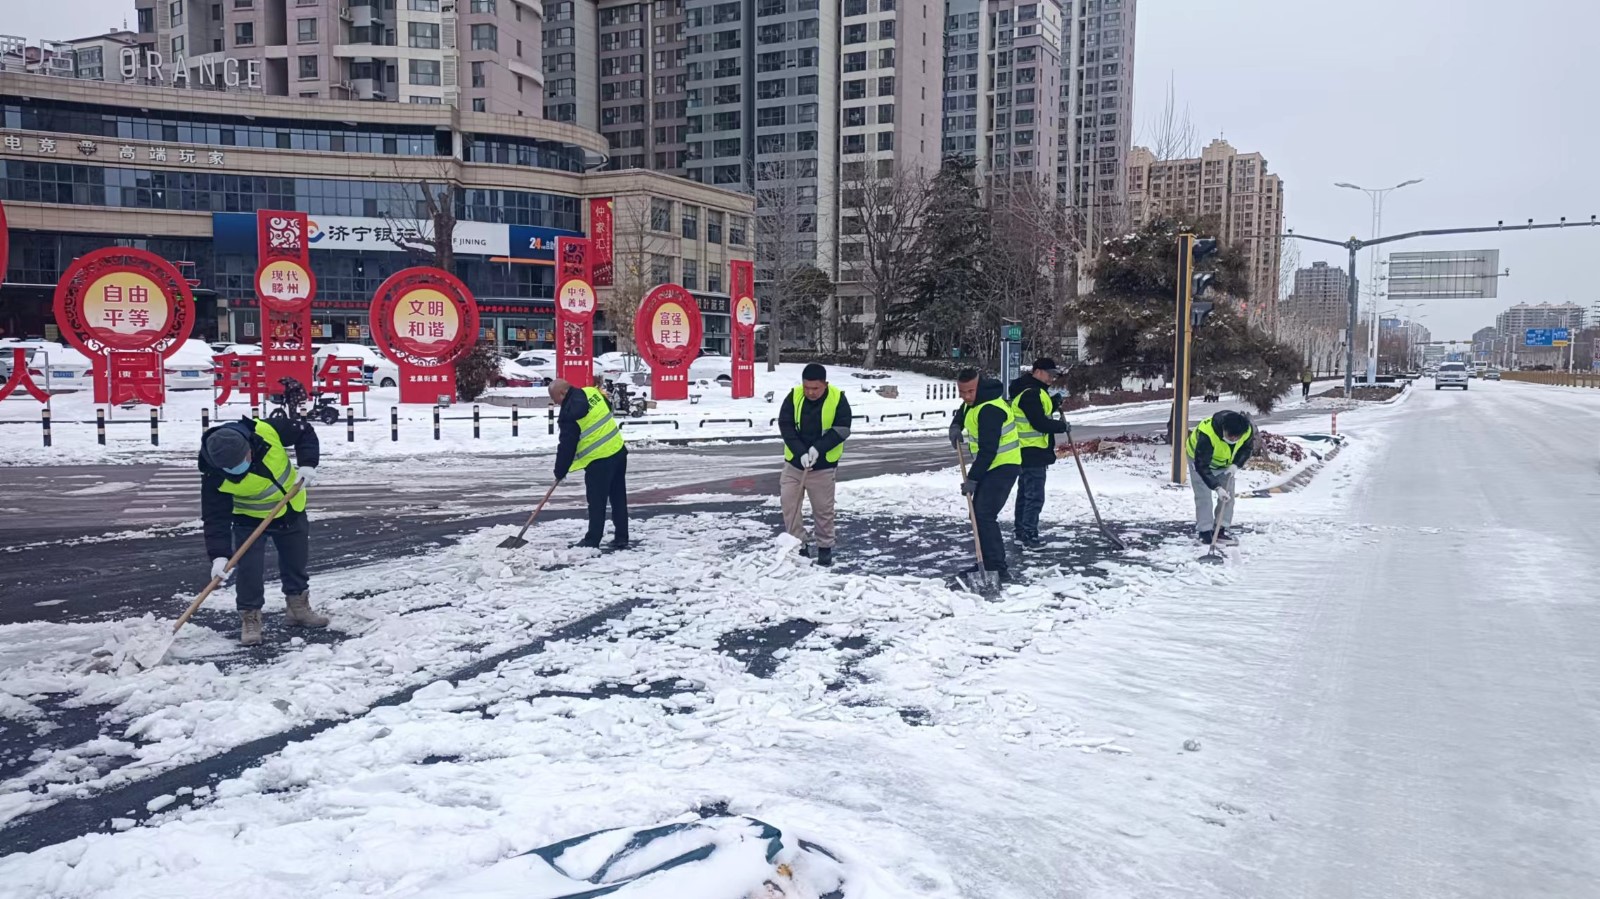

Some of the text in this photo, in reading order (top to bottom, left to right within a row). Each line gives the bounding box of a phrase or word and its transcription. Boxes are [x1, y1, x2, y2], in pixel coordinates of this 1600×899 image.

[119, 47, 262, 89] ORANGE
[4, 134, 226, 166] 电竞 高端玩家
[328, 226, 418, 243] 济宁银行
[595, 205, 606, 250] 仲家汇
[459, 238, 487, 247] JINING
[271, 269, 299, 281] 现代
[103, 284, 149, 304] 自由
[271, 282, 300, 295] 滕州
[567, 287, 587, 297] 中华
[408, 300, 444, 317] 文明
[103, 308, 150, 328] 平等
[660, 311, 682, 327] 富强
[408, 320, 445, 338] 和谐
[660, 330, 682, 344] 民主
[409, 374, 438, 383] 龙泉街道
